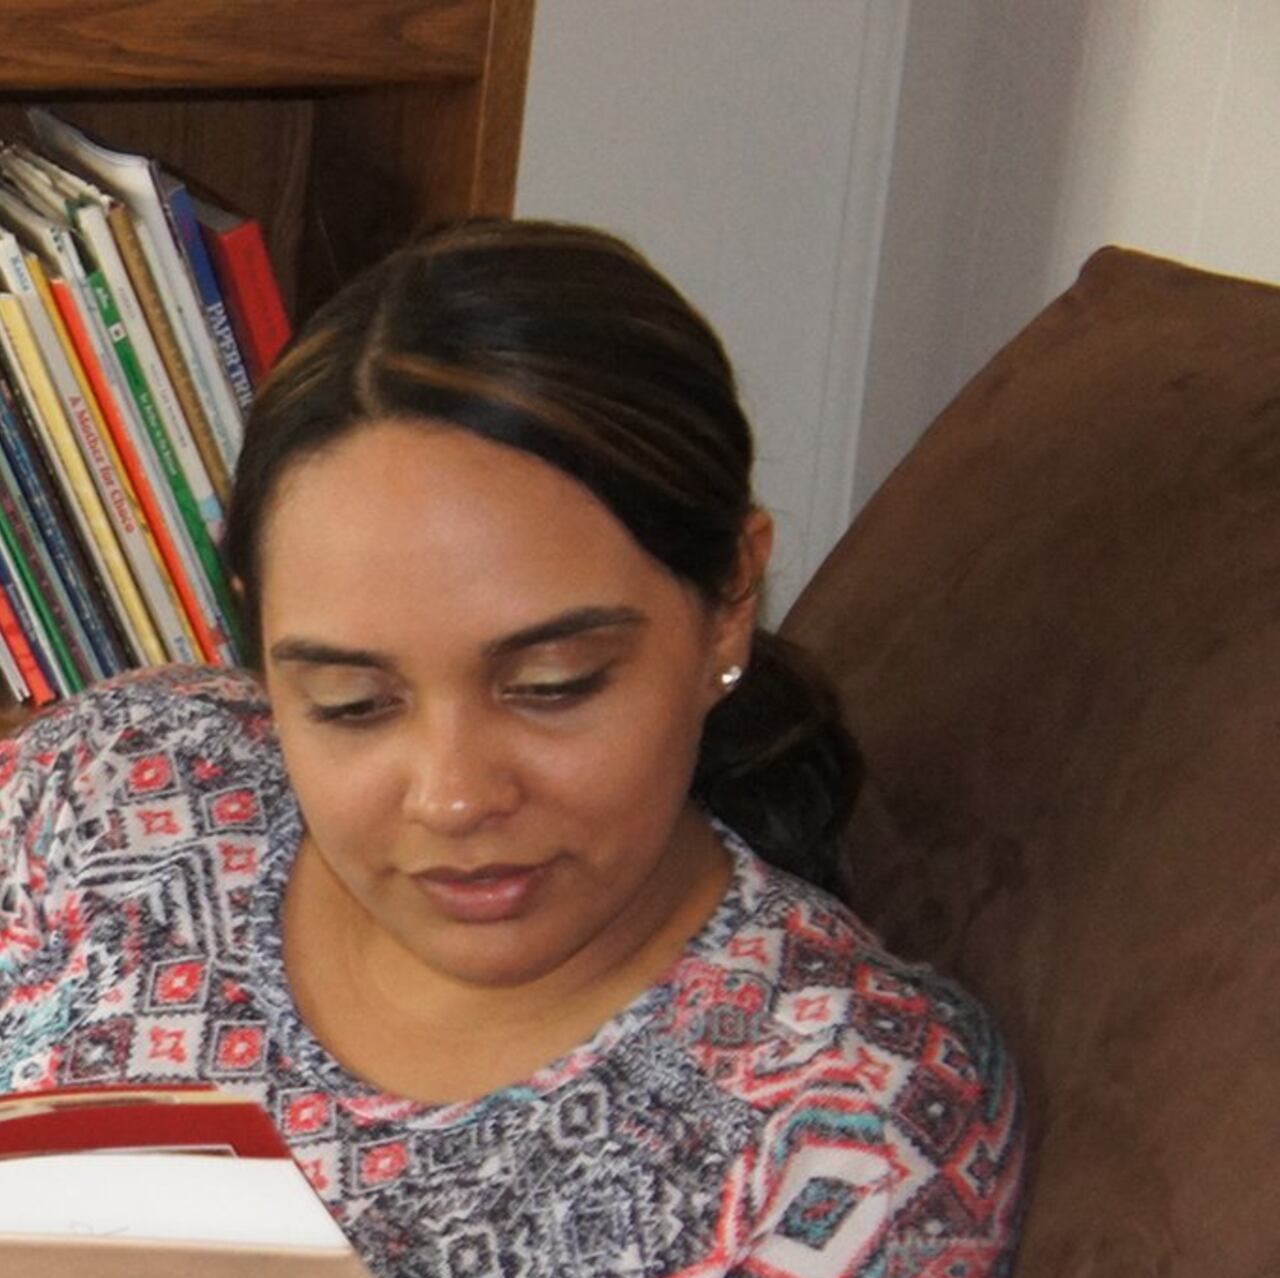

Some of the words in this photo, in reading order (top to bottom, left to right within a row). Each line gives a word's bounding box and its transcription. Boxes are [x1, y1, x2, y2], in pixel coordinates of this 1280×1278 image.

[204, 301, 240, 366] PAPER
[68, 393, 81, 406] A
[75, 408, 105, 464] Mother
[98, 464, 116, 487] for
[108, 488, 136, 535] Choco
